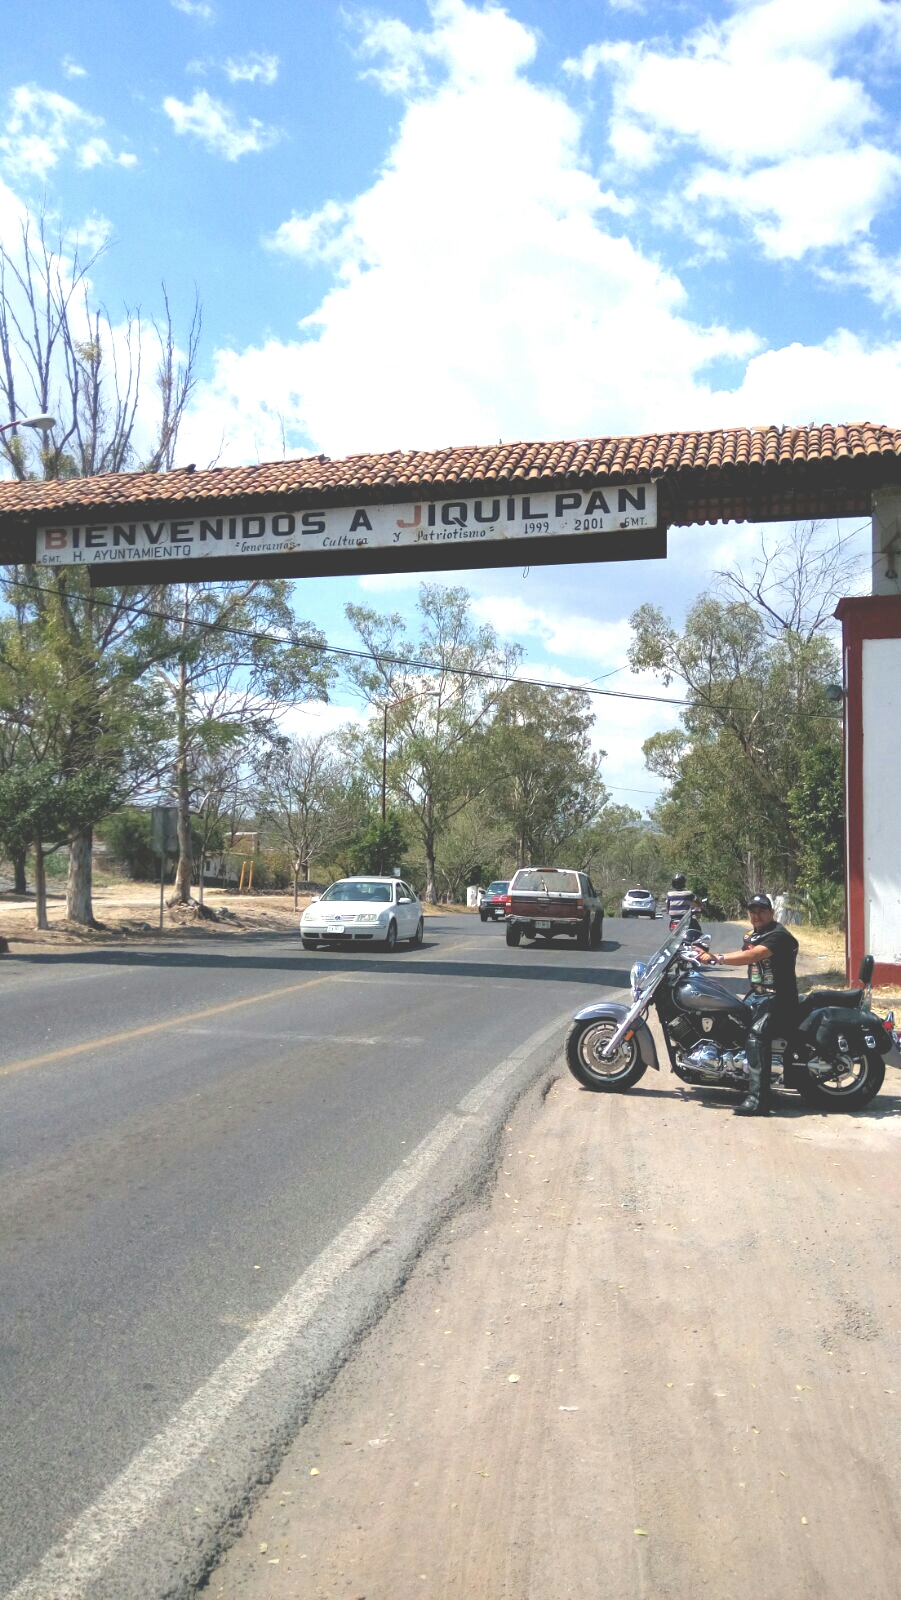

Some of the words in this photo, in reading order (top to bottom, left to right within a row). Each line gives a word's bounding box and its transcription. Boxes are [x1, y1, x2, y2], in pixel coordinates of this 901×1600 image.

[45, 512, 326, 550] BIENVENIDOS
[349, 509, 373, 532] A
[396, 487, 646, 528] JIQUILPAN
[524, 521, 549, 534] 1999
[574, 517, 604, 531] 2001
[322, 535, 368, 547] Cultura
[93, 545, 191, 560] AYUNTAMIENTO
